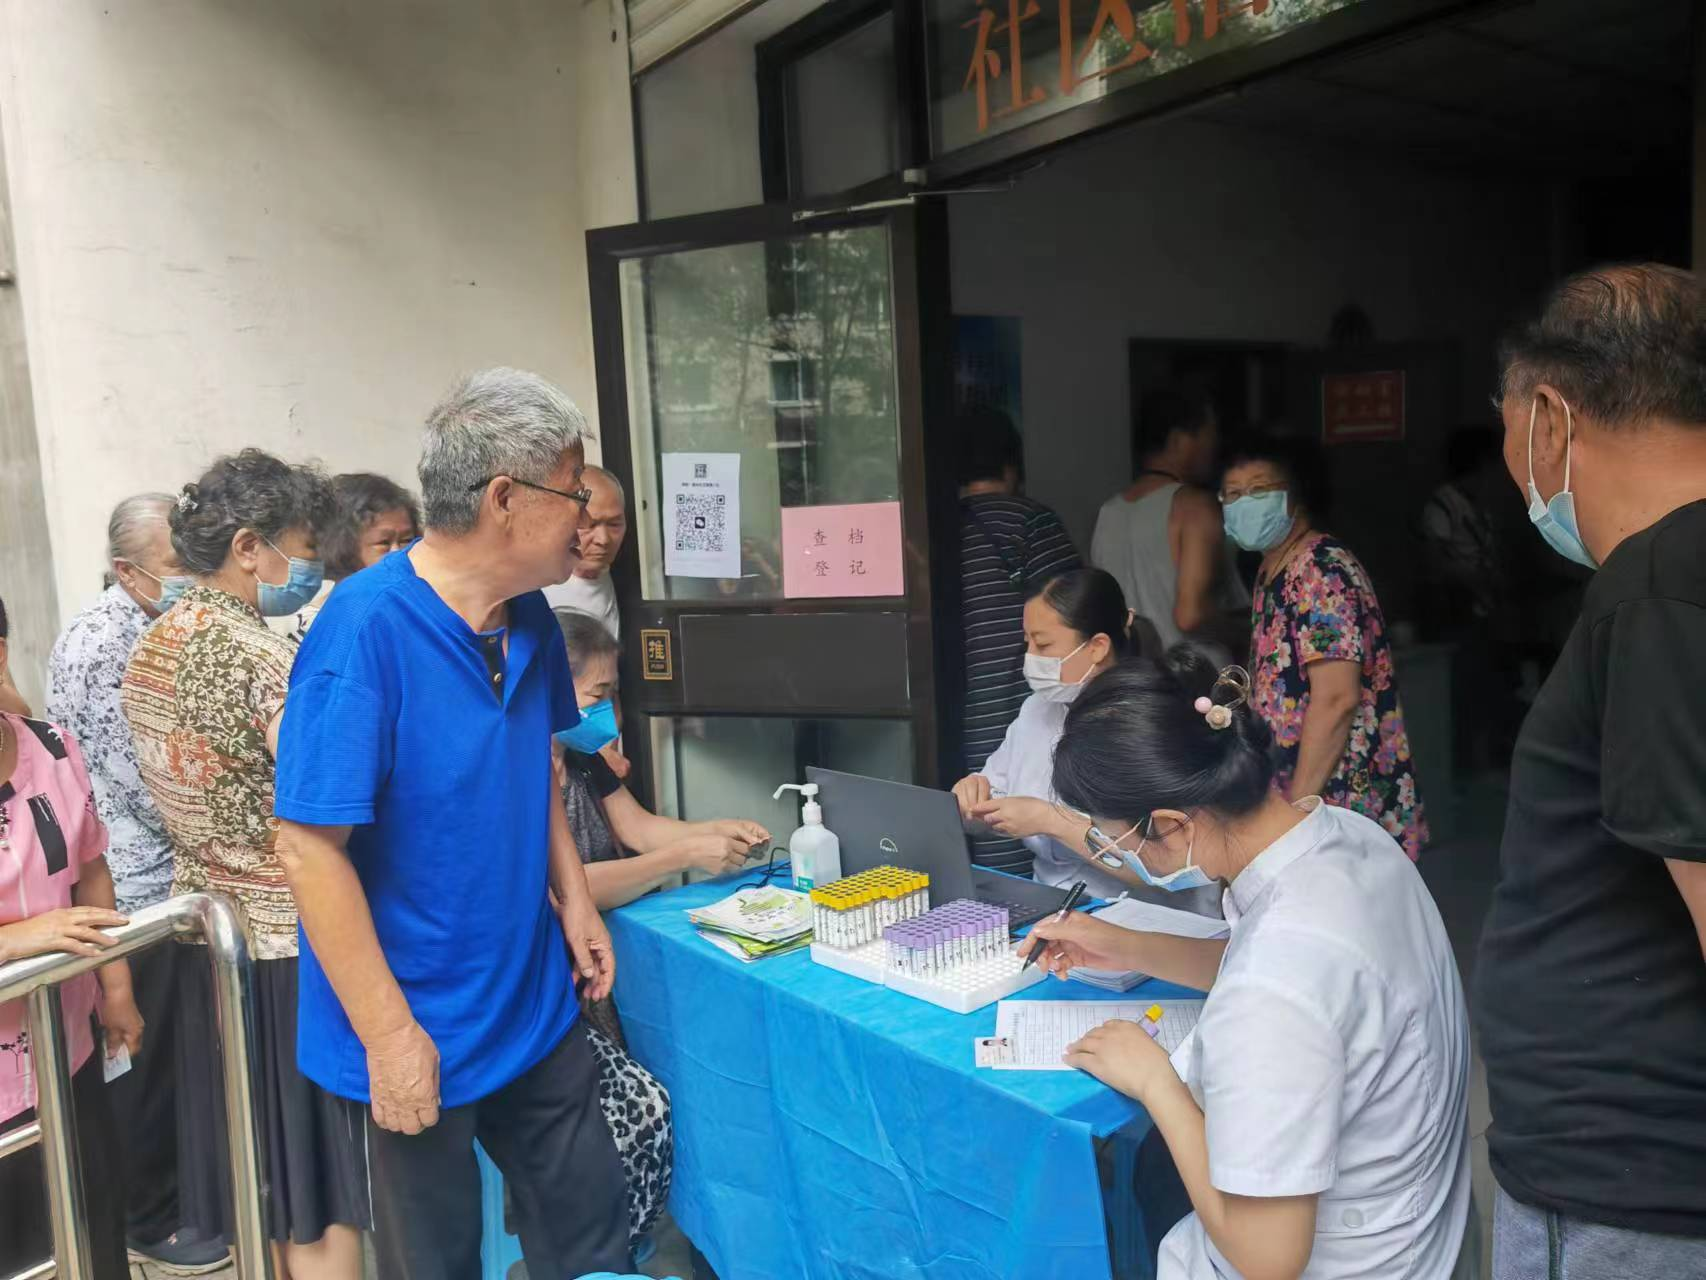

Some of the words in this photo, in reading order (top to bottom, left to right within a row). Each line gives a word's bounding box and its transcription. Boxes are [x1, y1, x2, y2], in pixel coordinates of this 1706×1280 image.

[961, 0, 1270, 133] 社区
[813, 528, 864, 546] 查档
[815, 560, 866, 577] 登记
[648, 639, 665, 660] 推
